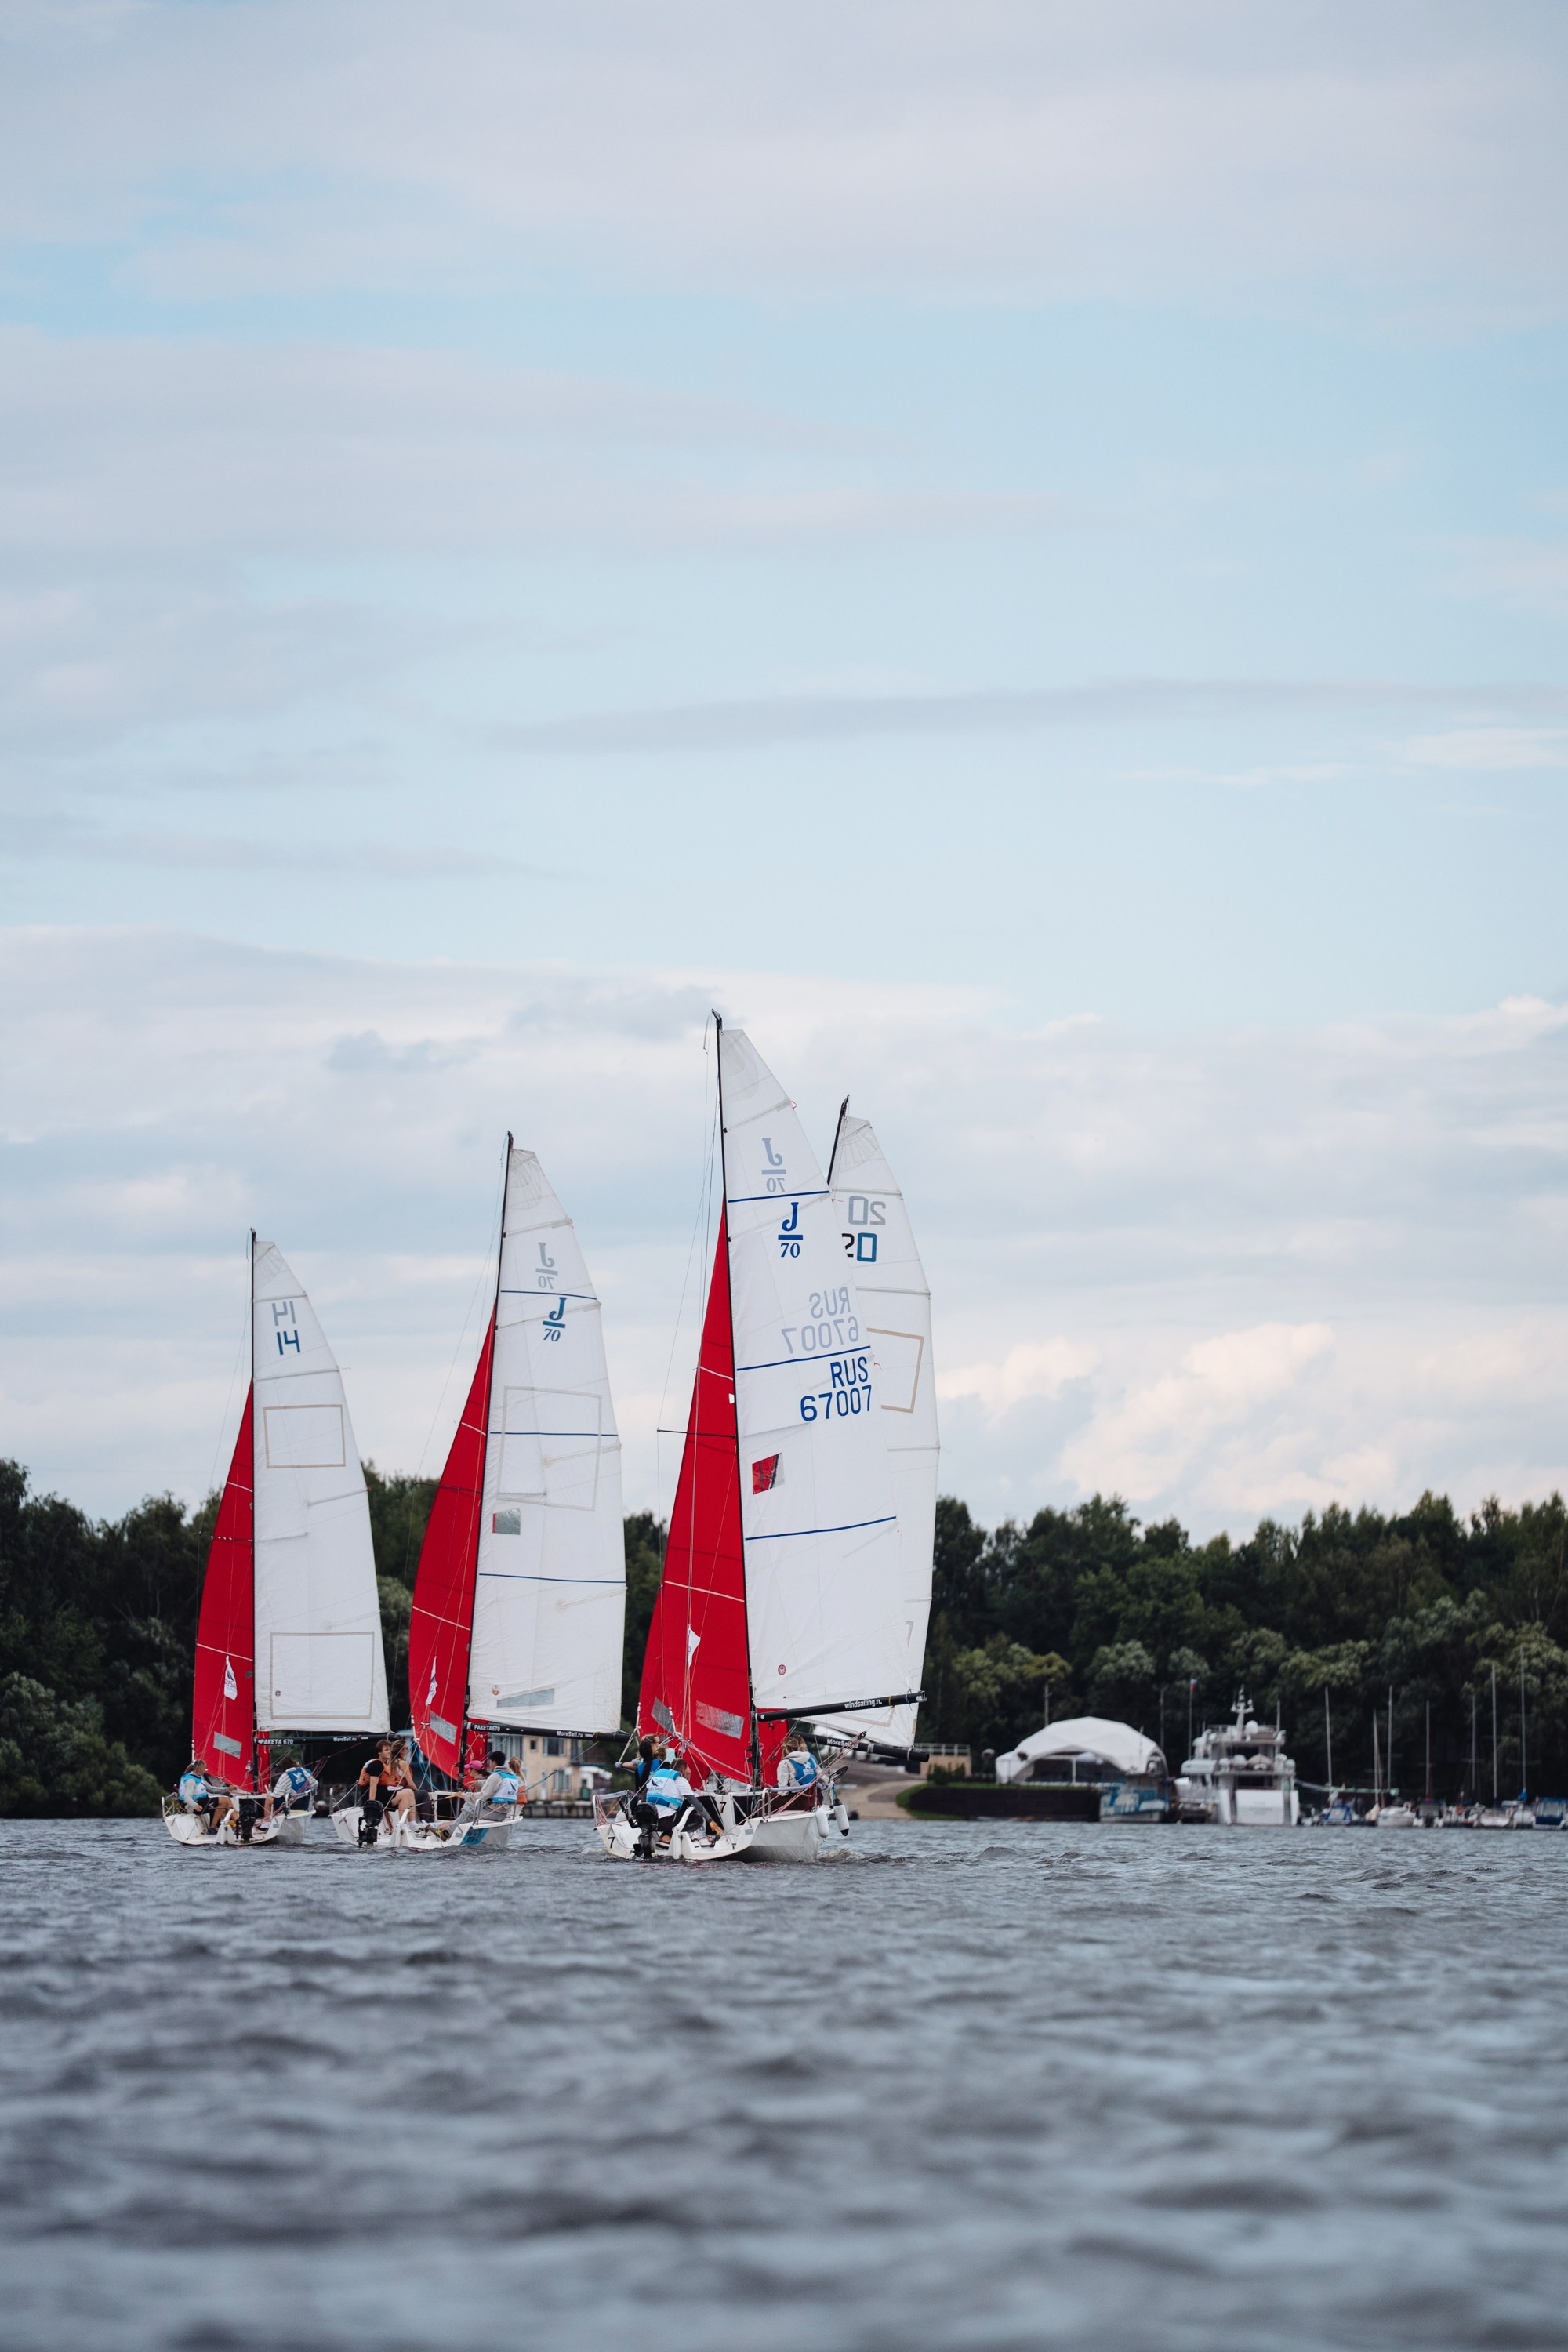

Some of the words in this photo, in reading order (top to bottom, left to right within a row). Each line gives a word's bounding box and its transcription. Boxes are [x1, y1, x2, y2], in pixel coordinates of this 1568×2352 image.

[782, 1202, 799, 1232] J
[780, 1243, 800, 1258] 70
[549, 1297, 567, 1321] J
[276, 1330, 300, 1355] 14
[543, 1328, 561, 1342] 70
[830, 1356, 869, 1388] RUS
[800, 1385, 872, 1421] 67007
[719, 1801, 727, 1813] 7
[608, 1836, 615, 1849] 7
